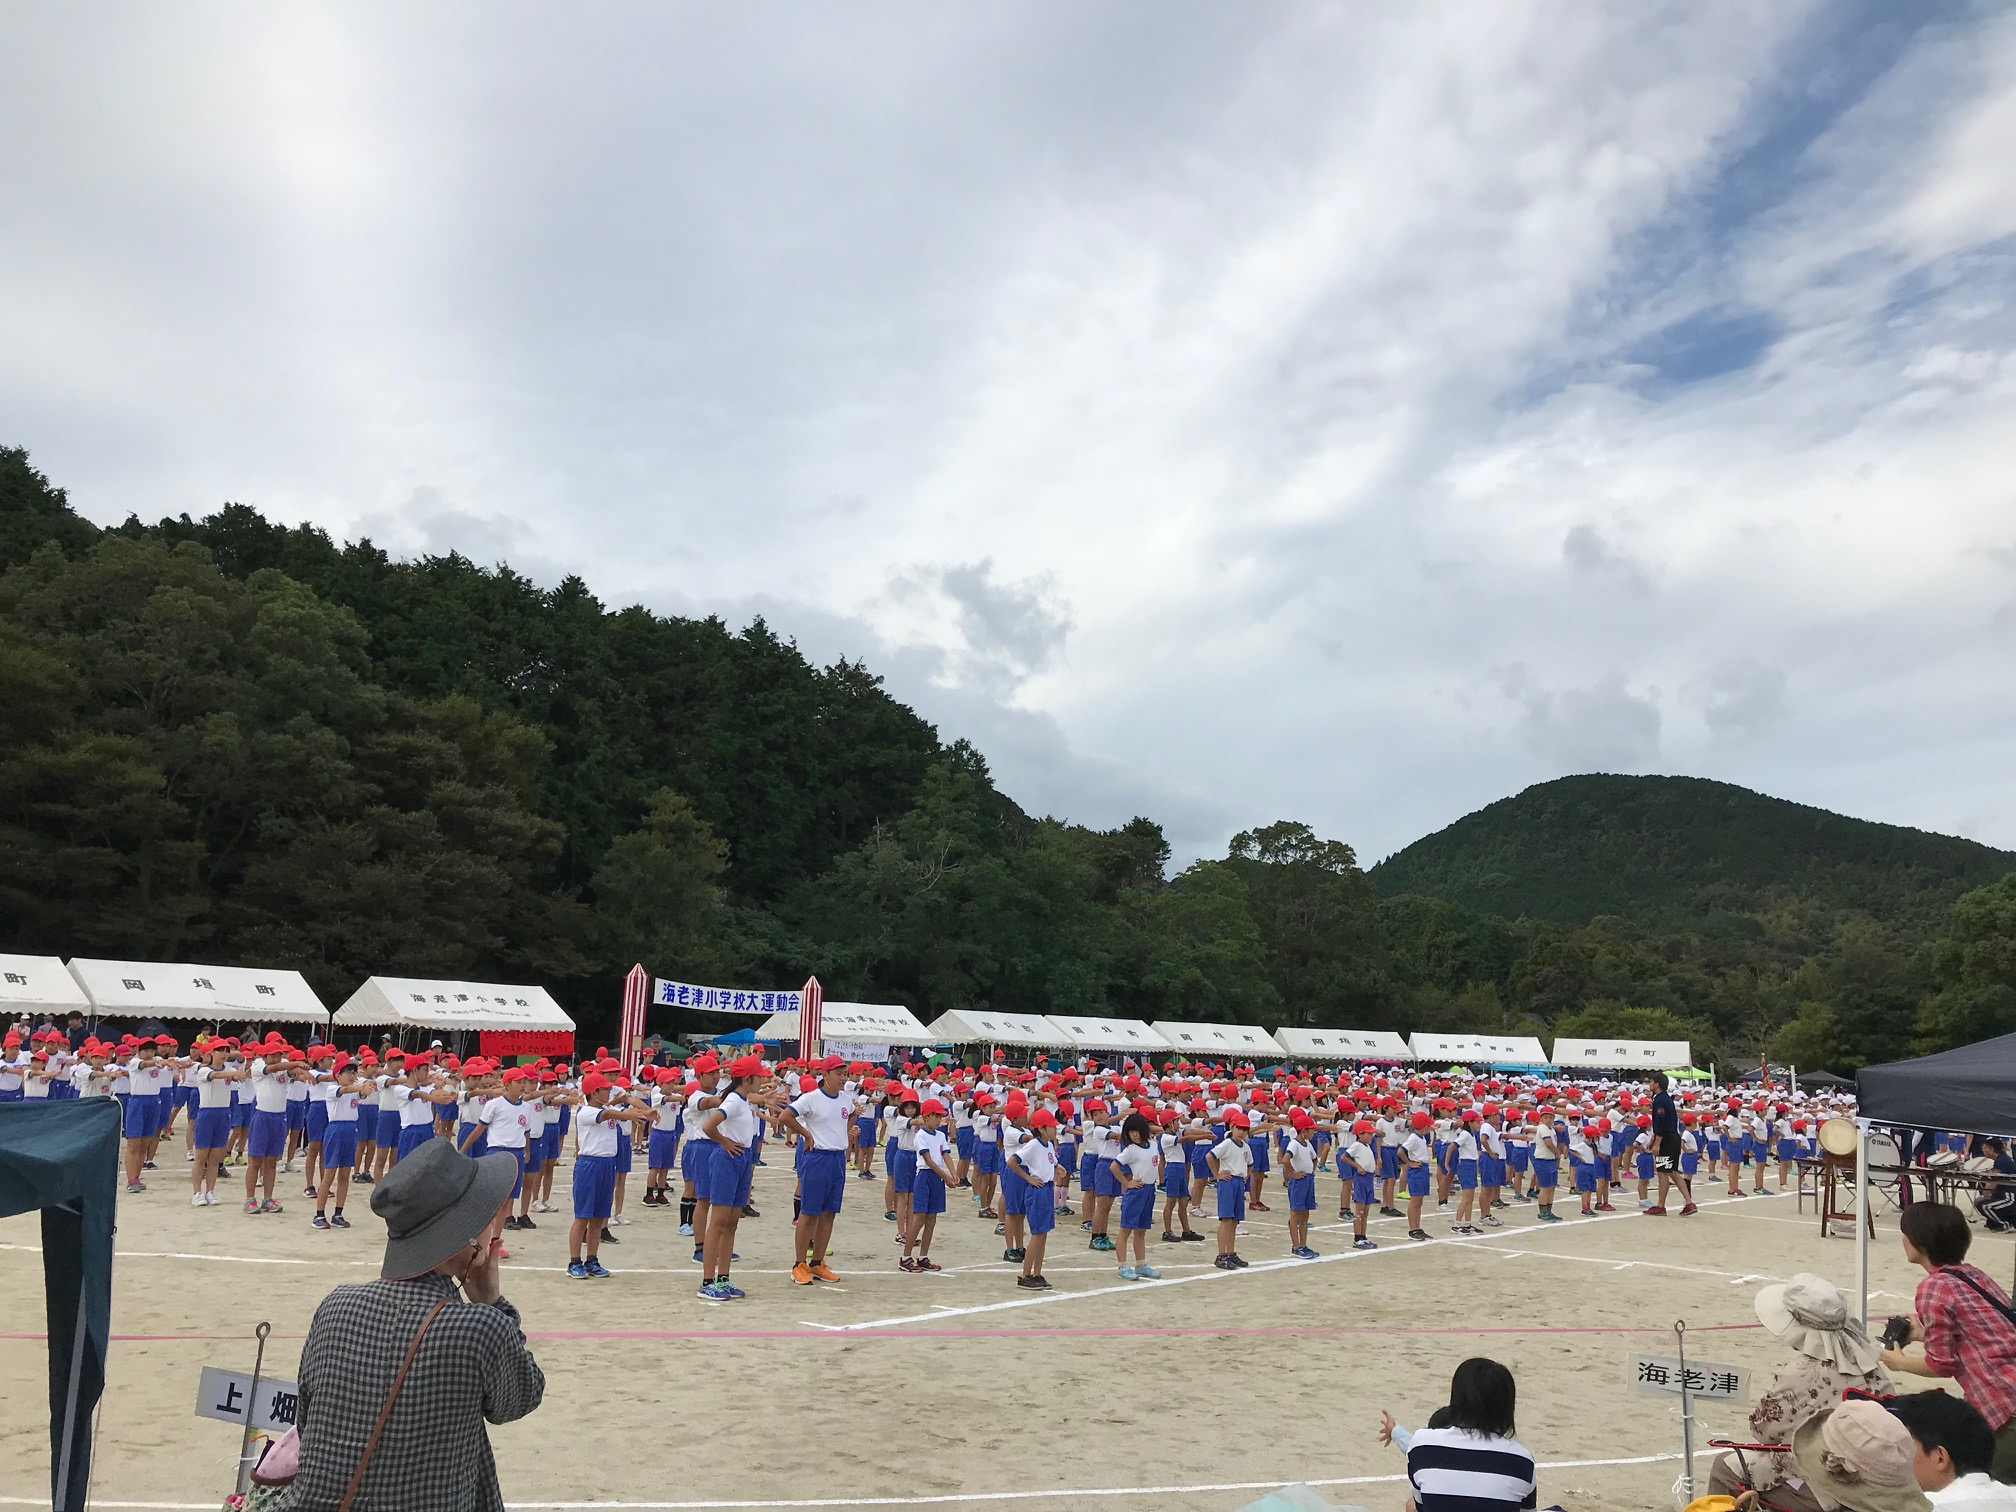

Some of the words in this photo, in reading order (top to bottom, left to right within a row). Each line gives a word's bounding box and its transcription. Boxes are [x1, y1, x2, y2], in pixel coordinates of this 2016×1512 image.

[410, 993, 530, 1007] 海老津小学校
[662, 983, 800, 1012] 海老津小学校大運動会
[1638, 1361, 1739, 1394] 海老津
[216, 1381, 299, 1426] 上畑
